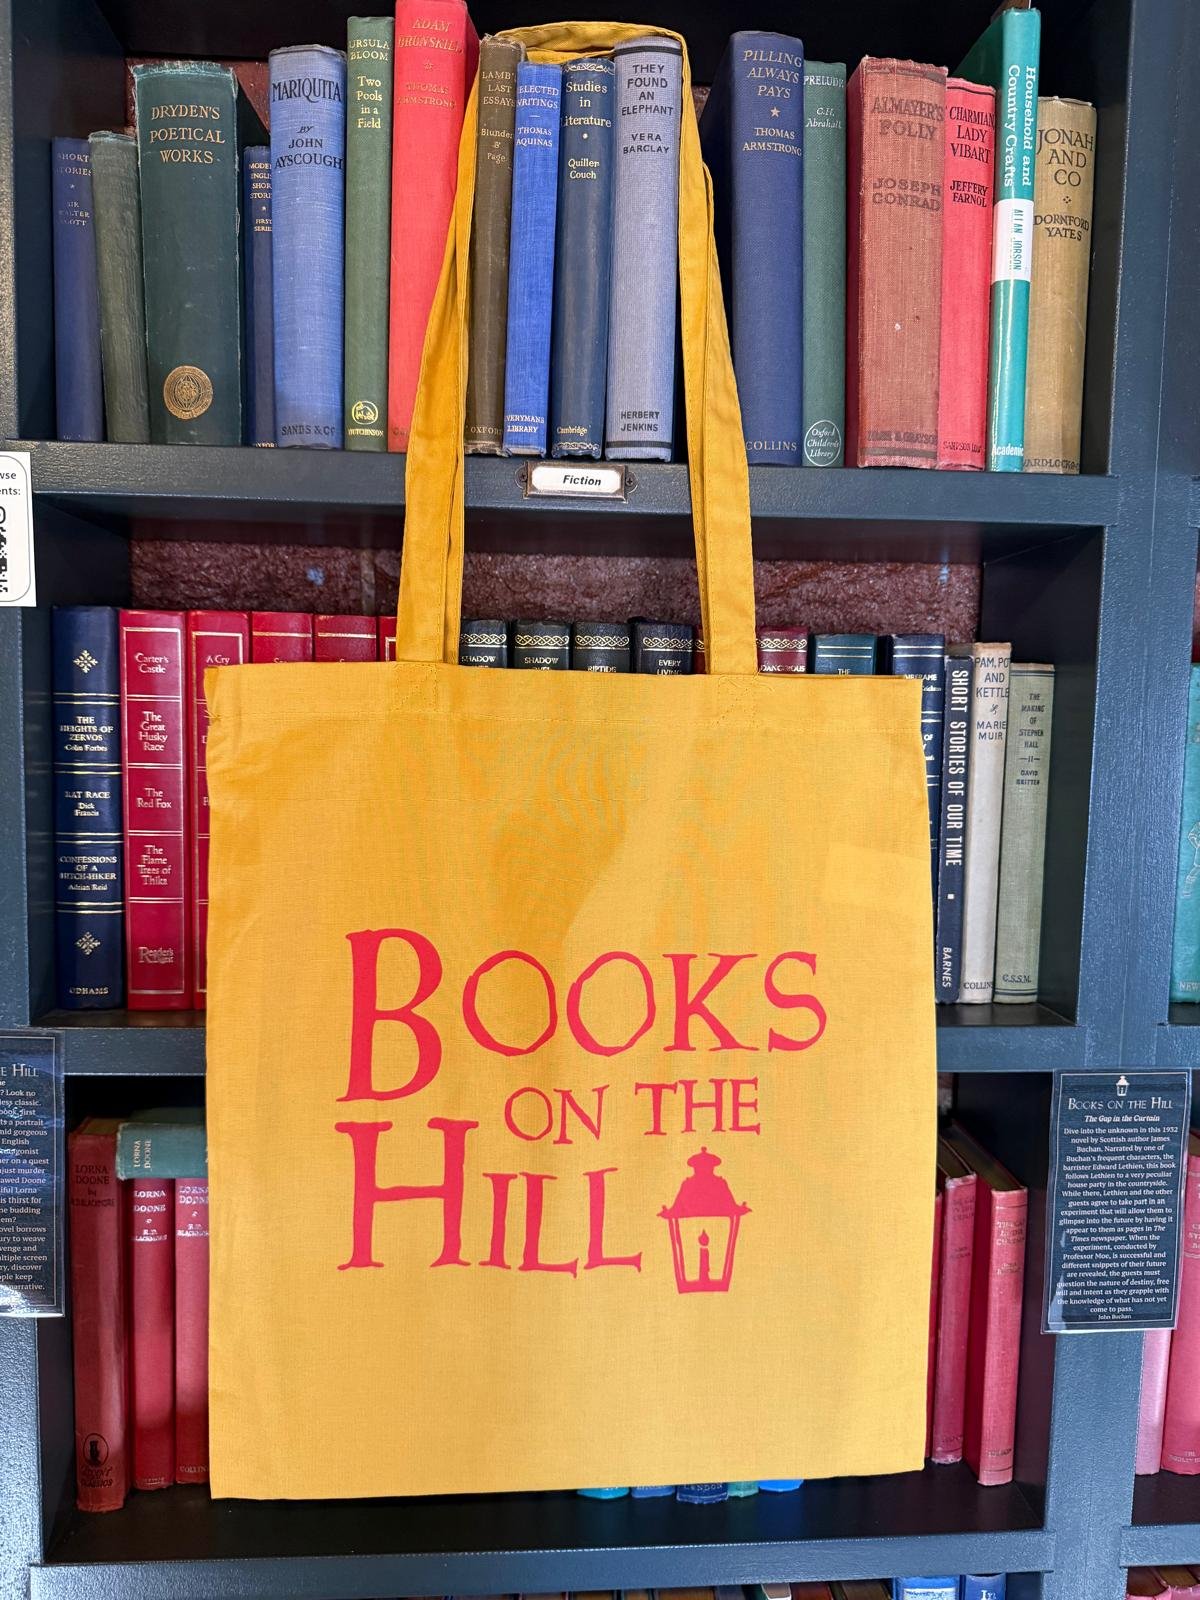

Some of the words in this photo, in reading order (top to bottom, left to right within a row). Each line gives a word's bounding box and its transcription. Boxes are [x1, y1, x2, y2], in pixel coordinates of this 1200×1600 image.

[349, 39, 390, 50] URSULA
[350, 51, 389, 61] BLOOM
[743, 49, 802, 68] PILLING
[632, 64, 665, 74] THEY
[747, 67, 799, 84] ALWAYS
[357, 76, 382, 87] Two
[627, 77, 668, 88] FOUND
[488, 83, 513, 94] LAST
[566, 82, 608, 94] Studies
[757, 85, 791, 99] PAYS
[357, 90, 383, 102] Pools
[579, 96, 591, 107] in
[639, 91, 655, 101] AN
[1004, 64, 1021, 131] Country
[151, 104, 221, 120] DRYDEN'S
[360, 106, 371, 115] in
[373, 107, 379, 115] a
[621, 104, 674, 116] ELEPHANT
[1023, 66, 1037, 150] Household
[950, 106, 995, 129] CHARMIAN
[357, 118, 382, 129] Field
[150, 127, 226, 144] POETICAL
[518, 126, 552, 136] THOMAS
[754, 127, 795, 140] THOMAS
[956, 125, 987, 144] LADY
[516, 138, 553, 148] AQUINAS
[632, 133, 662, 142] VERA
[1037, 128, 1094, 155] JONAH
[288, 139, 324, 149] JOHN
[623, 145, 669, 155] BARCLAY
[951, 143, 991, 164] VIBART
[160, 149, 214, 164] WORKS
[274, 153, 343, 171] AYSCOUGH
[1004, 135, 1018, 188] Crafts
[1047, 149, 1087, 168] AND
[570, 170, 597, 180] Couch
[1022, 158, 1033, 186] and
[1054, 169, 1082, 187] CO
[873, 177, 941, 196] JOSEPH
[950, 180, 989, 197] JEFFERY
[872, 192, 941, 212] CONRAD
[953, 192, 987, 208] FARNOL
[1034, 214, 1090, 232] DORNFORD
[1047, 226, 1082, 241] YATES
[620, 411, 660, 420] HERBERT
[281, 425, 311, 436] SANDS
[507, 425, 538, 433] LIBRARY
[620, 423, 659, 432] JENKINS
[746, 441, 797, 451] COLLINS
[562, 475, 602, 486] Fiction
[214, 655, 230, 667] Cry
[524, 657, 559, 665] SHADOW
[138, 663, 166, 674] Castle
[984, 672, 1005, 683] AND
[950, 670, 969, 713] SHORT
[76, 716, 95, 725] THE
[142, 711, 162, 722] The
[140, 722, 165, 732] Great
[976, 721, 1007, 730] MARIE
[138, 733, 169, 742] Husky
[978, 731, 1003, 740] MUIR
[143, 742, 165, 751] Race
[949, 721, 966, 775] STORIES
[144, 788, 164, 797] The
[947, 781, 964, 796] OF
[86, 791, 111, 799] RACE
[137, 798, 154, 808] Red
[157, 799, 172, 808] Fox
[946, 804, 964, 829] OUR
[144, 845, 164, 854] The
[945, 836, 963, 866] TIME
[141, 855, 168, 865] Flame
[942, 946, 952, 988] BARNES
[335, 928, 827, 1103] BOOKS
[504, 1084, 610, 1144] ON
[634, 1076, 761, 1136] THE
[334, 1117, 643, 1278] HILL
